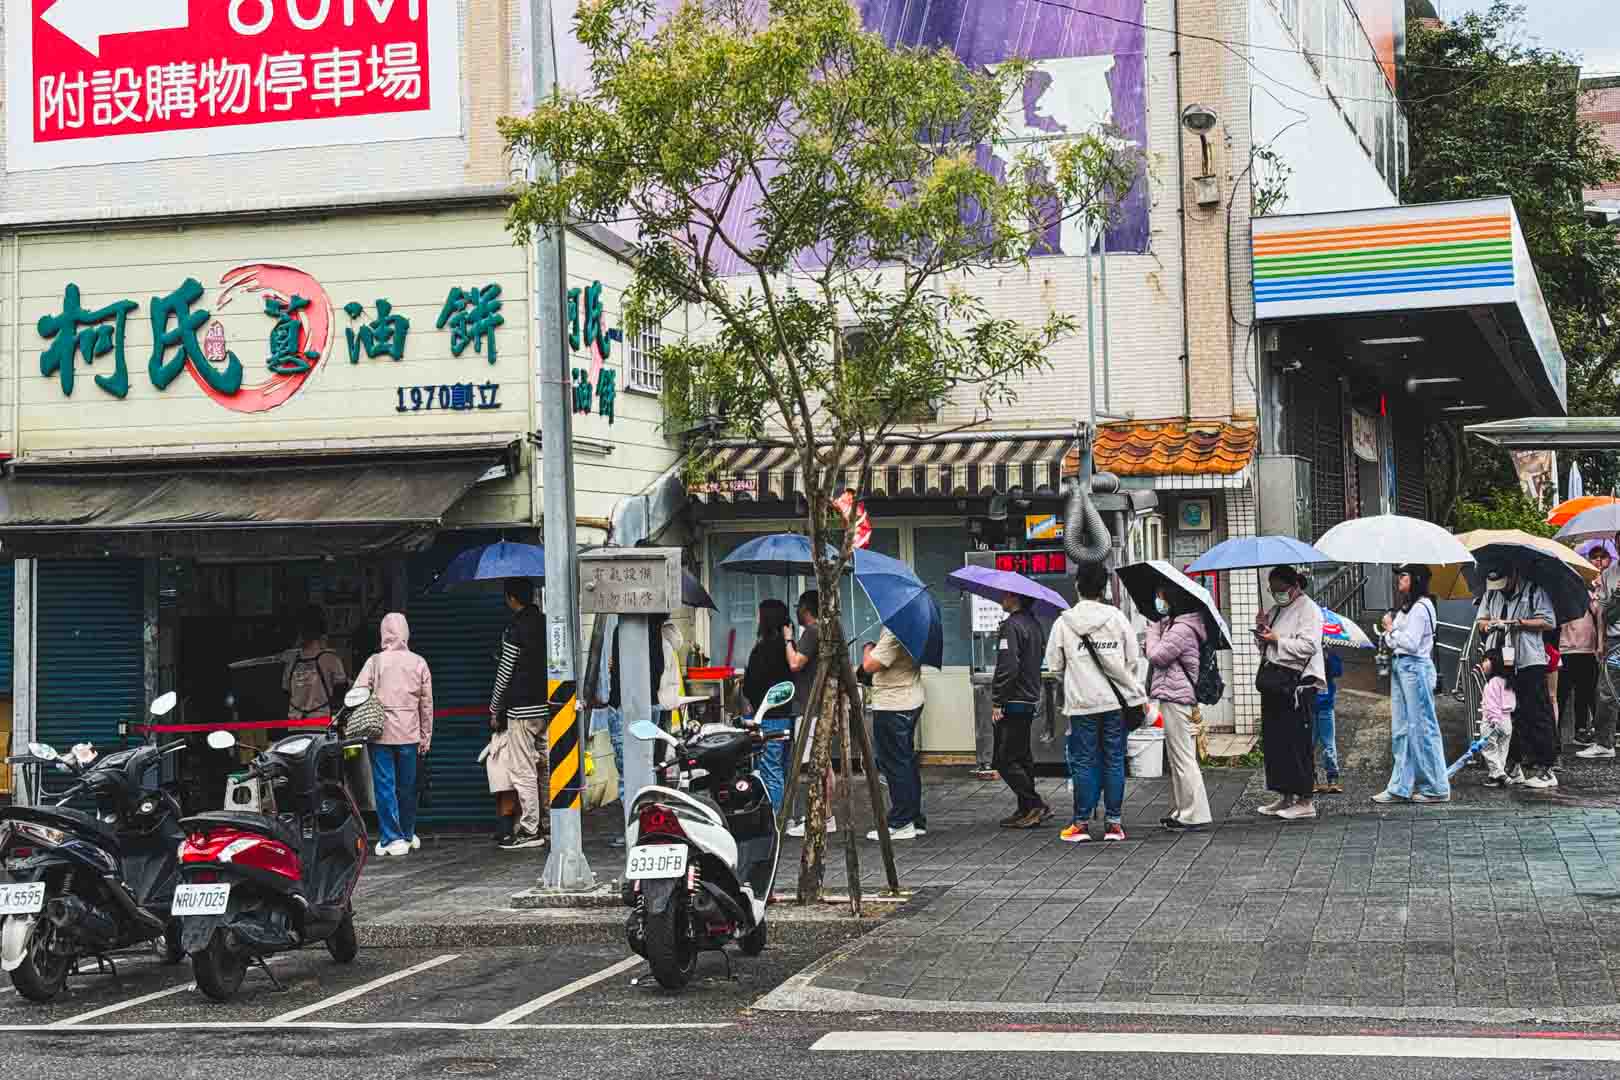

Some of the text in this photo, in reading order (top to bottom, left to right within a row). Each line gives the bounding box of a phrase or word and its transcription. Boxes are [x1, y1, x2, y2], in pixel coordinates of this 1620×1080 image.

[38, 42, 423, 131] 附設購物停車場
[176, 890, 226, 908] NRU-7025
